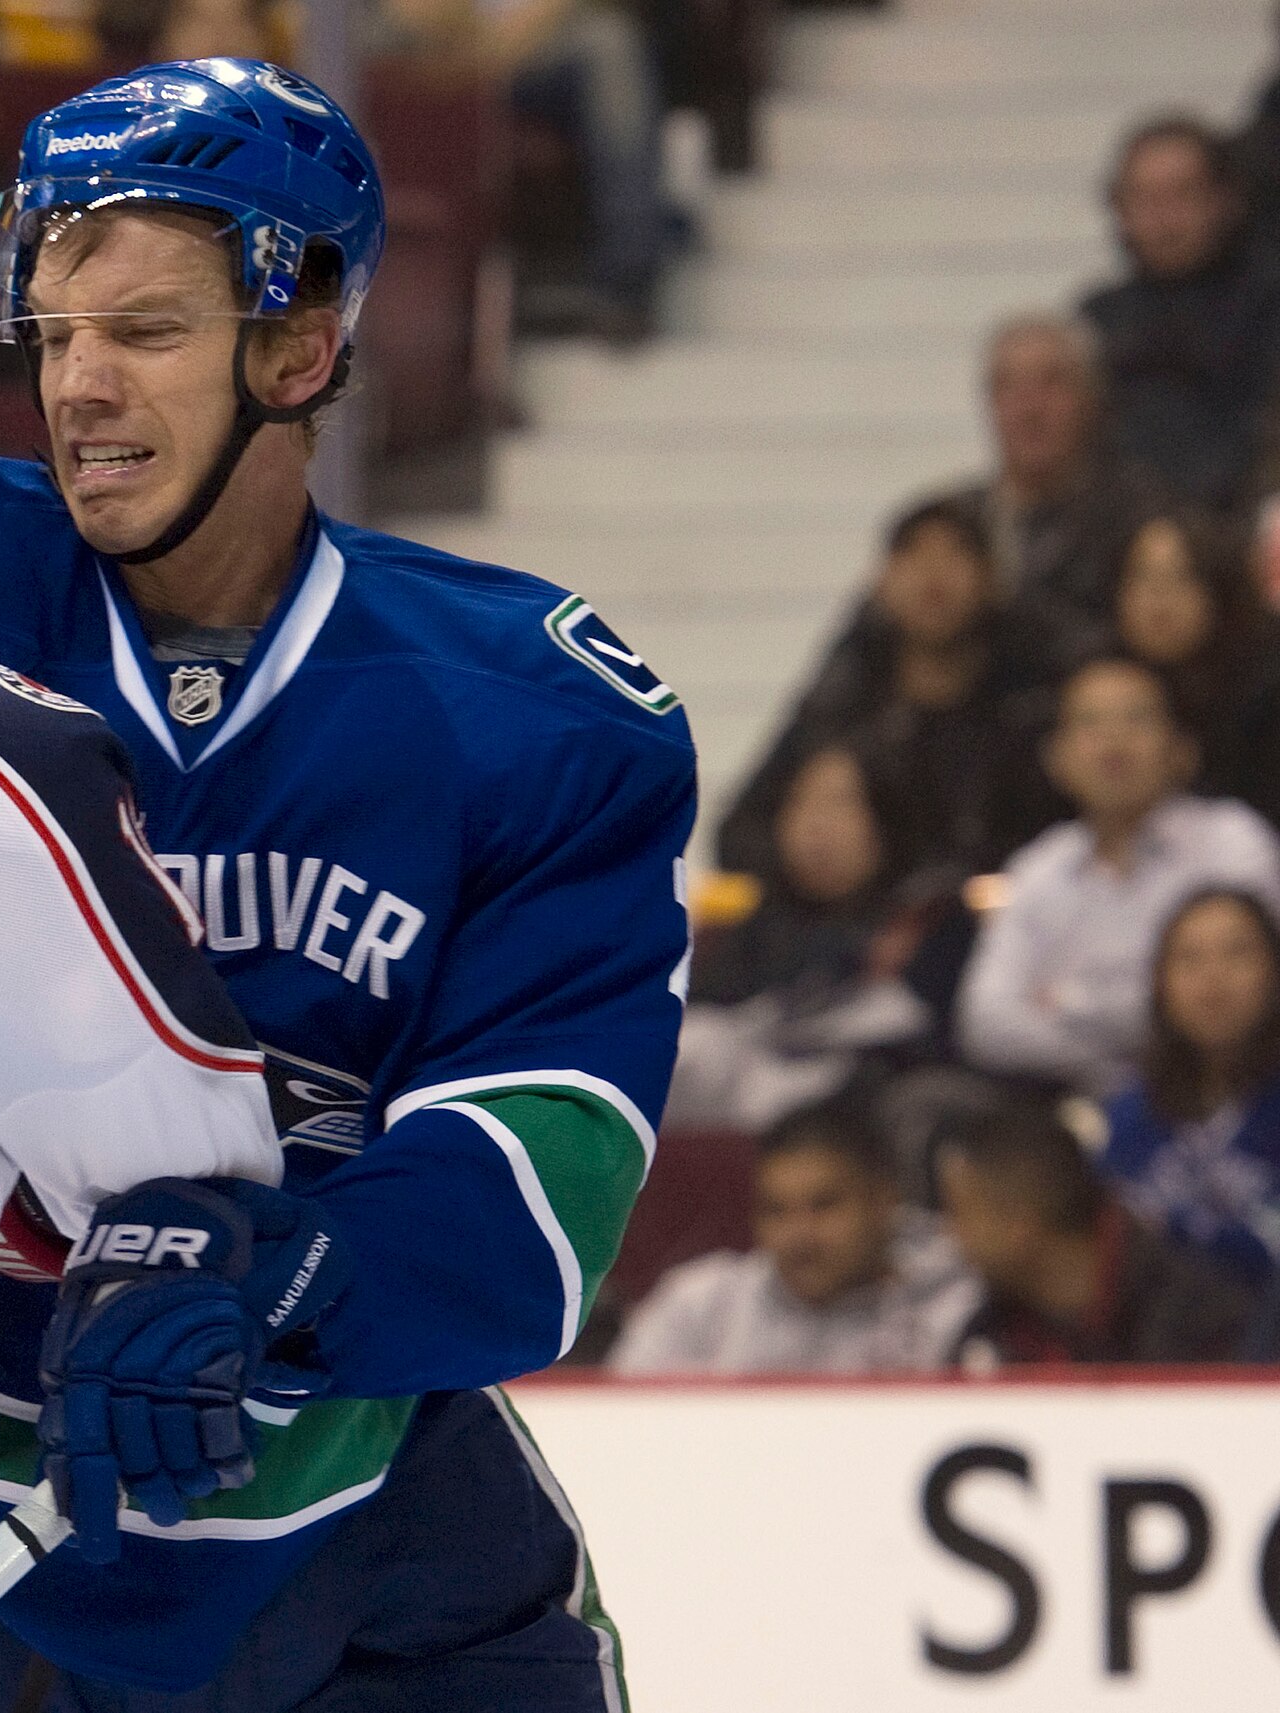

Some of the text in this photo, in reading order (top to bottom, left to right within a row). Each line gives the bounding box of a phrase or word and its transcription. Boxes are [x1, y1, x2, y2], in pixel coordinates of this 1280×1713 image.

[45, 130, 127, 156] Reebok
[266, 1231, 332, 1328] SAMUELSSON
[920, 1443, 1280, 1677] SP
